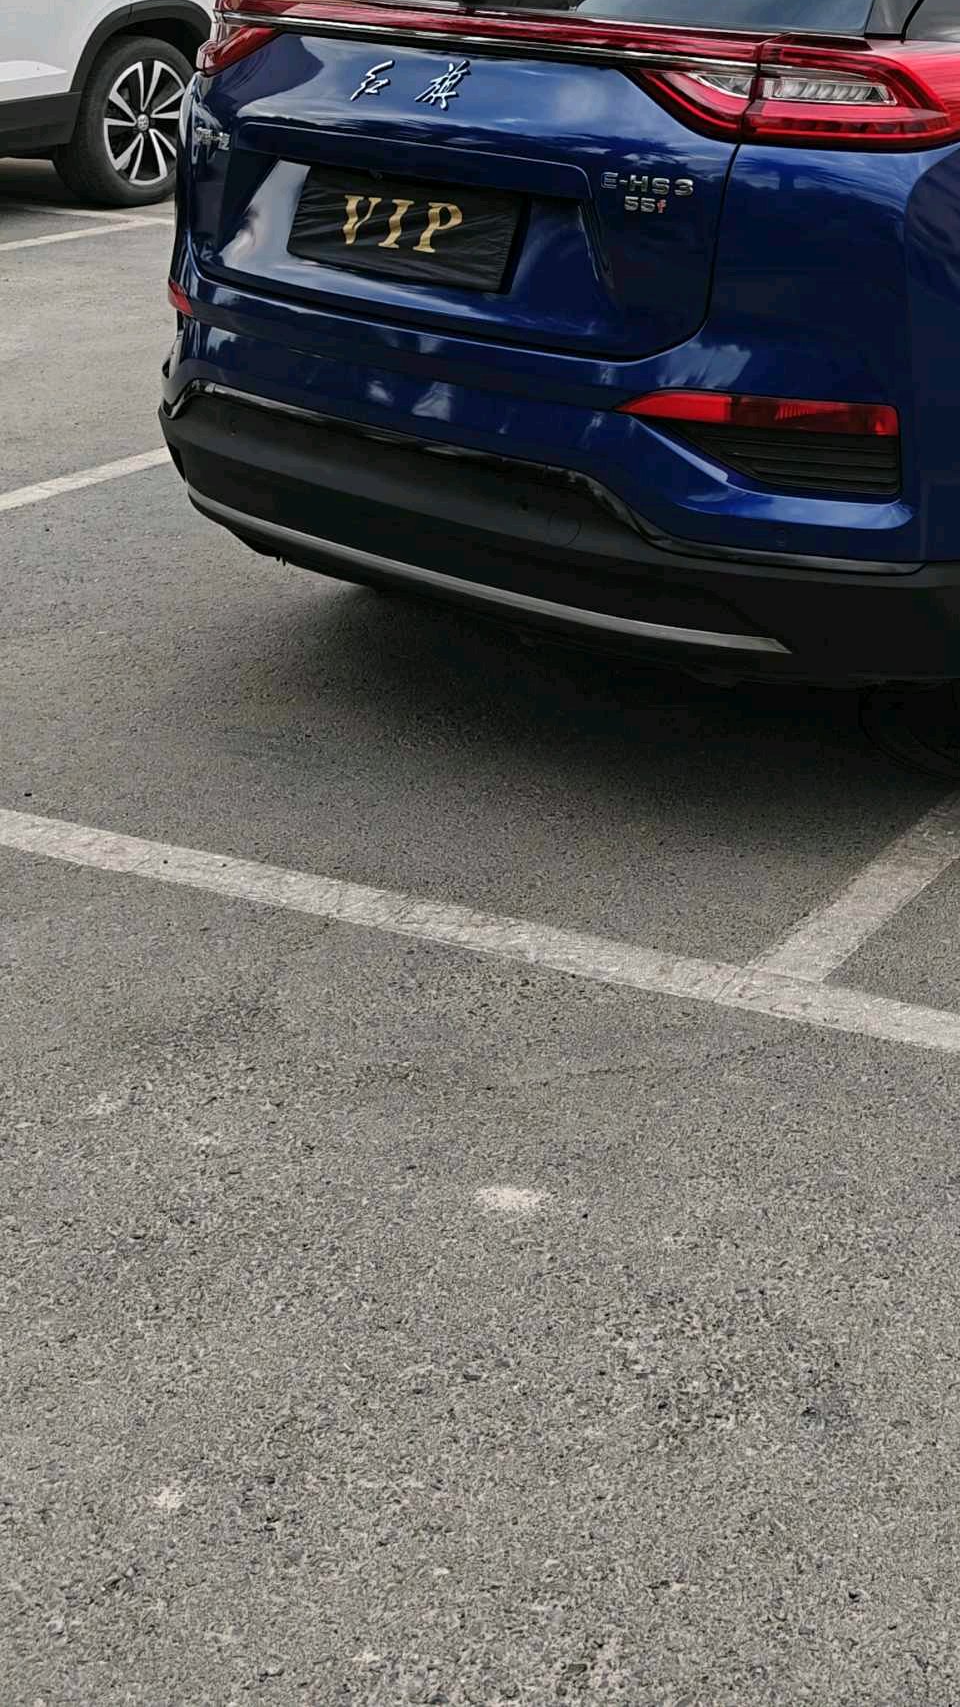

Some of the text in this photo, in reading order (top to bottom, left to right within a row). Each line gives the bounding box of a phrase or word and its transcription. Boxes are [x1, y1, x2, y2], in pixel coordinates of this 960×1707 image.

[350, 59, 471, 110] 红旗
[601, 171, 694, 196] E-HS3
[342, 194, 464, 253] VIP
